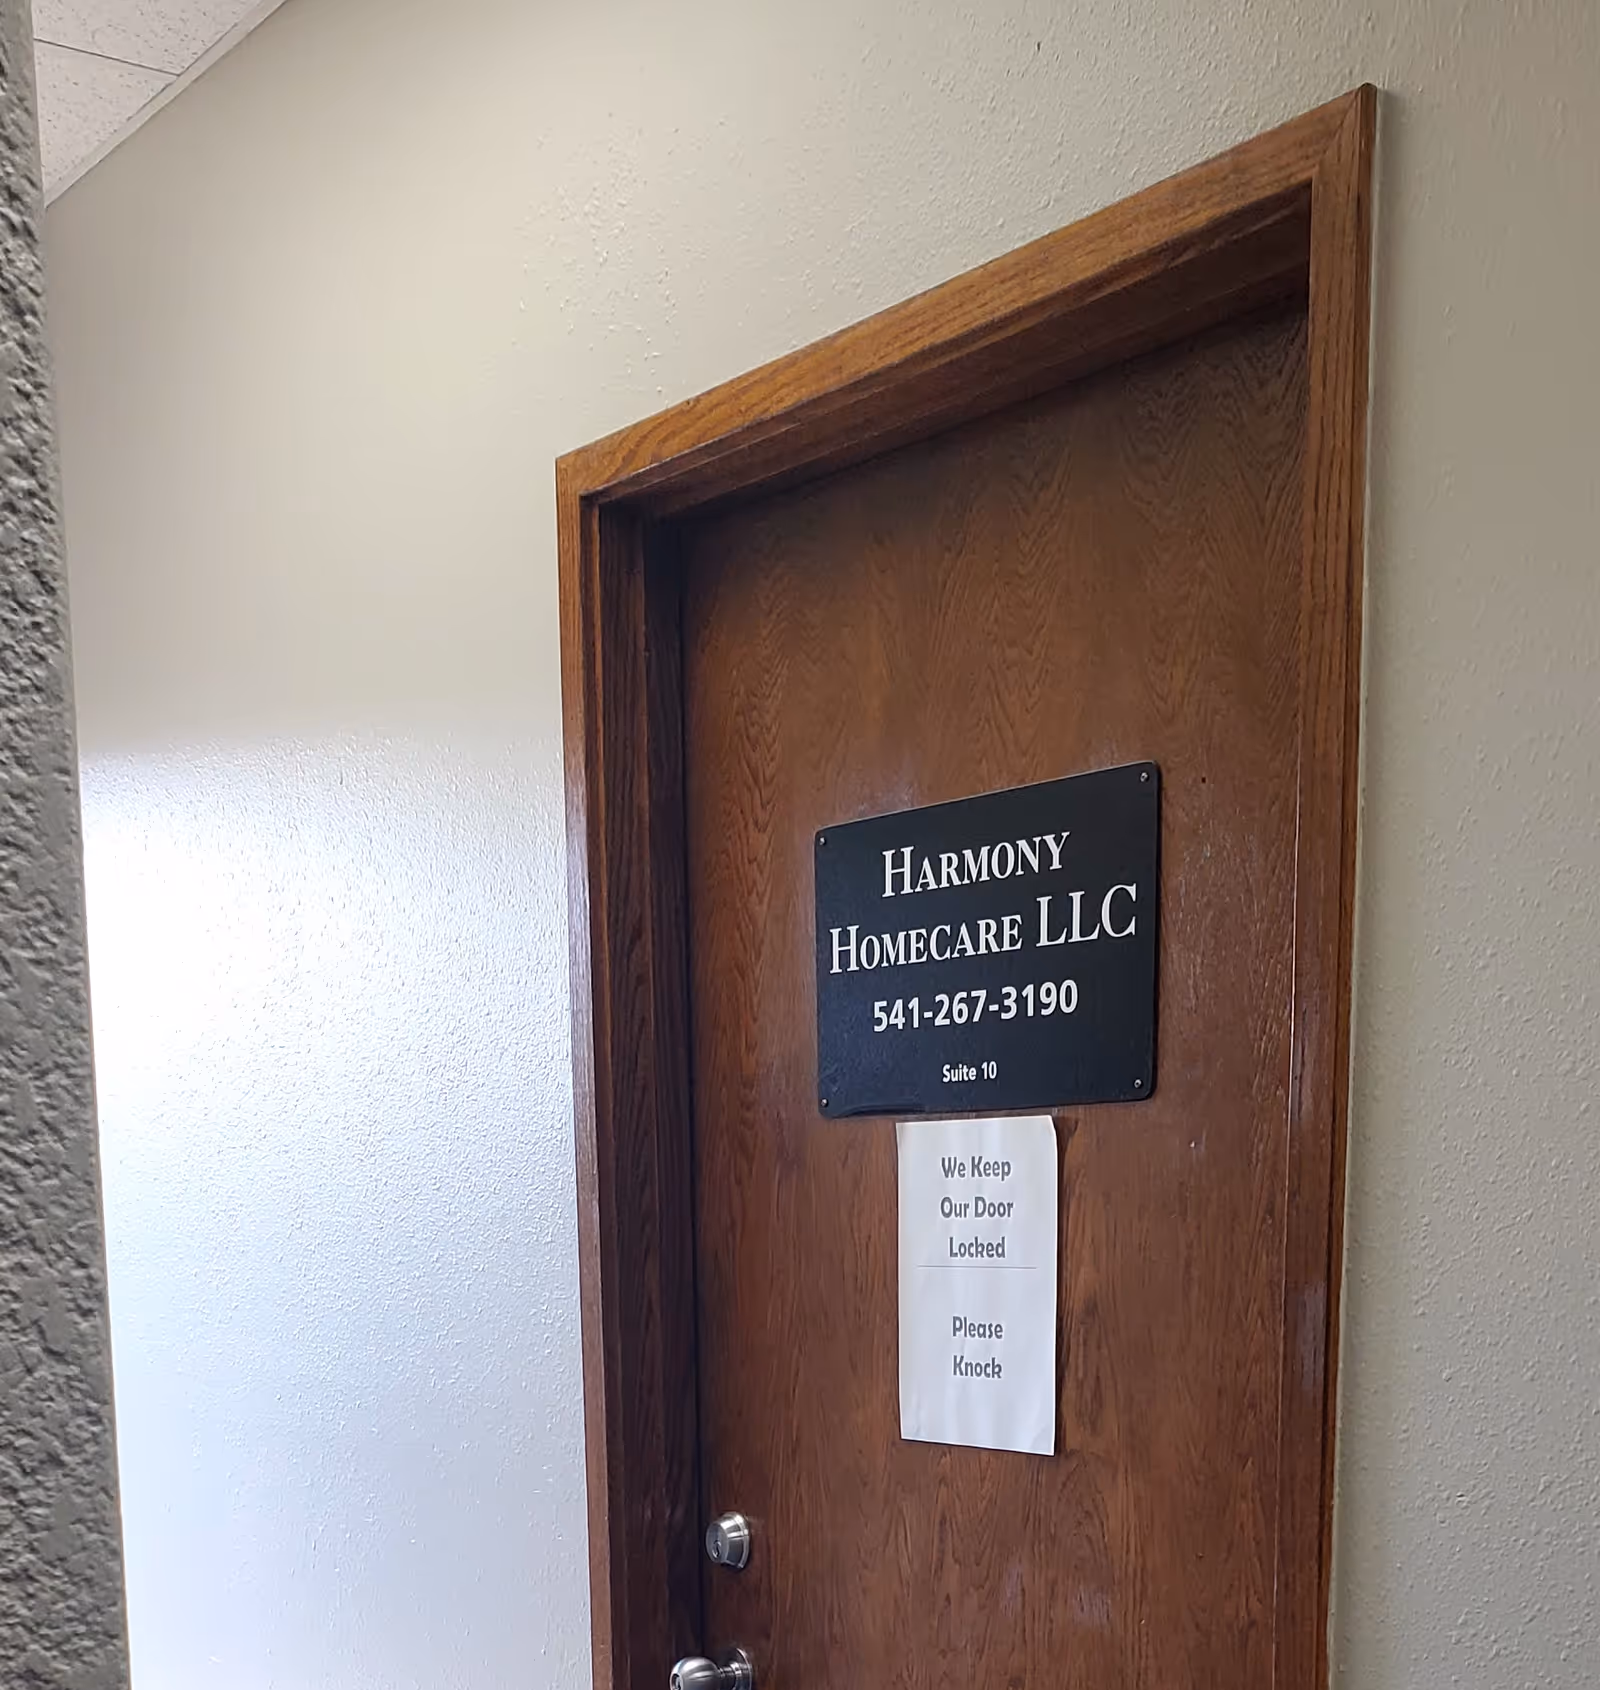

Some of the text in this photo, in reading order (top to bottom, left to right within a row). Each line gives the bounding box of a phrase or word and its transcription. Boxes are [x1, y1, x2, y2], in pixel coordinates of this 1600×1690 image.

[882, 831, 1070, 897] HARMONY
[829, 883, 1137, 974] HOMECARE LLC
[873, 979, 1078, 1032] 541-267-3190
[942, 1061, 997, 1083] Suite 10
[941, 1156, 1012, 1181] We Keep
[940, 1196, 1014, 1218] Our Door
[949, 1237, 1006, 1259] Locked
[952, 1316, 1003, 1339] Please
[953, 1355, 1002, 1379] Knock
